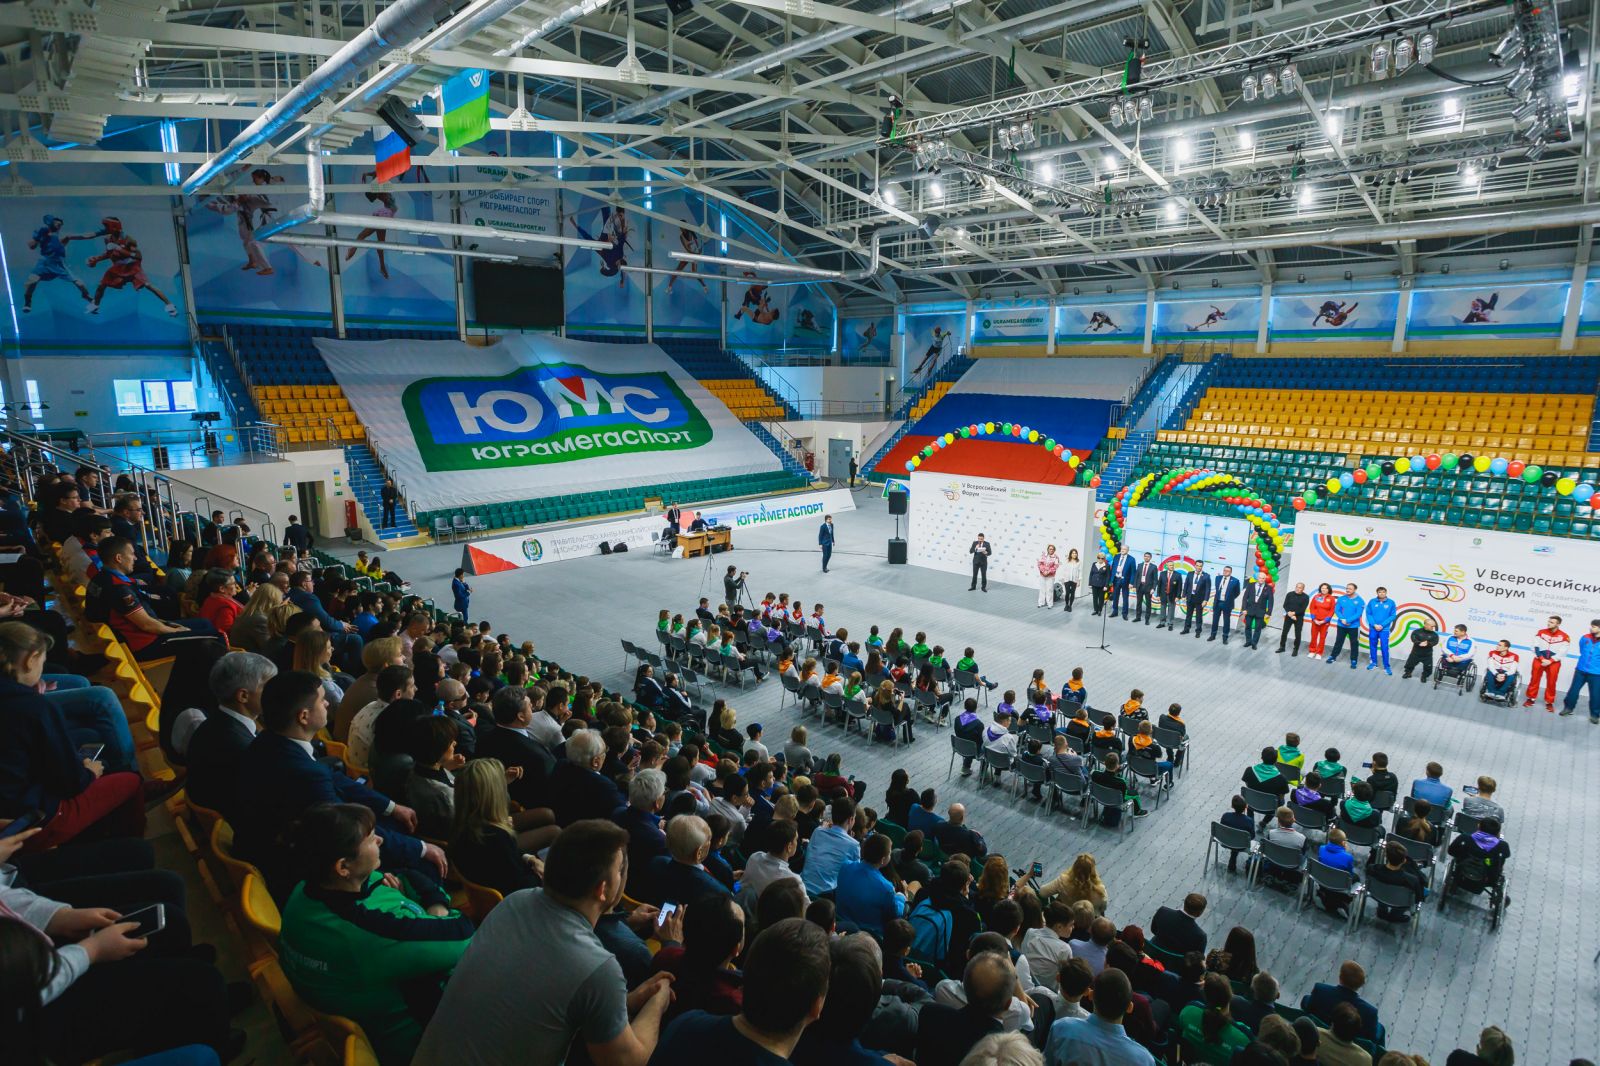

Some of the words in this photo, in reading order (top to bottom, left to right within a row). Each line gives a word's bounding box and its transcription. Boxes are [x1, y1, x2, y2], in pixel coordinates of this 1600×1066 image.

[480, 202, 540, 216] #ЮГРАМЕГАСПОРТ
[487, 219, 546, 232] UGRAMEGASPORT.RU
[447, 375, 670, 435] ЮМС
[736, 502, 824, 527] ЮГРАМЕГАСПОРТ
[1476, 568, 1486, 578] V
[1473, 582, 1526, 599] Форум
[1467, 614, 1487, 623] 2020
